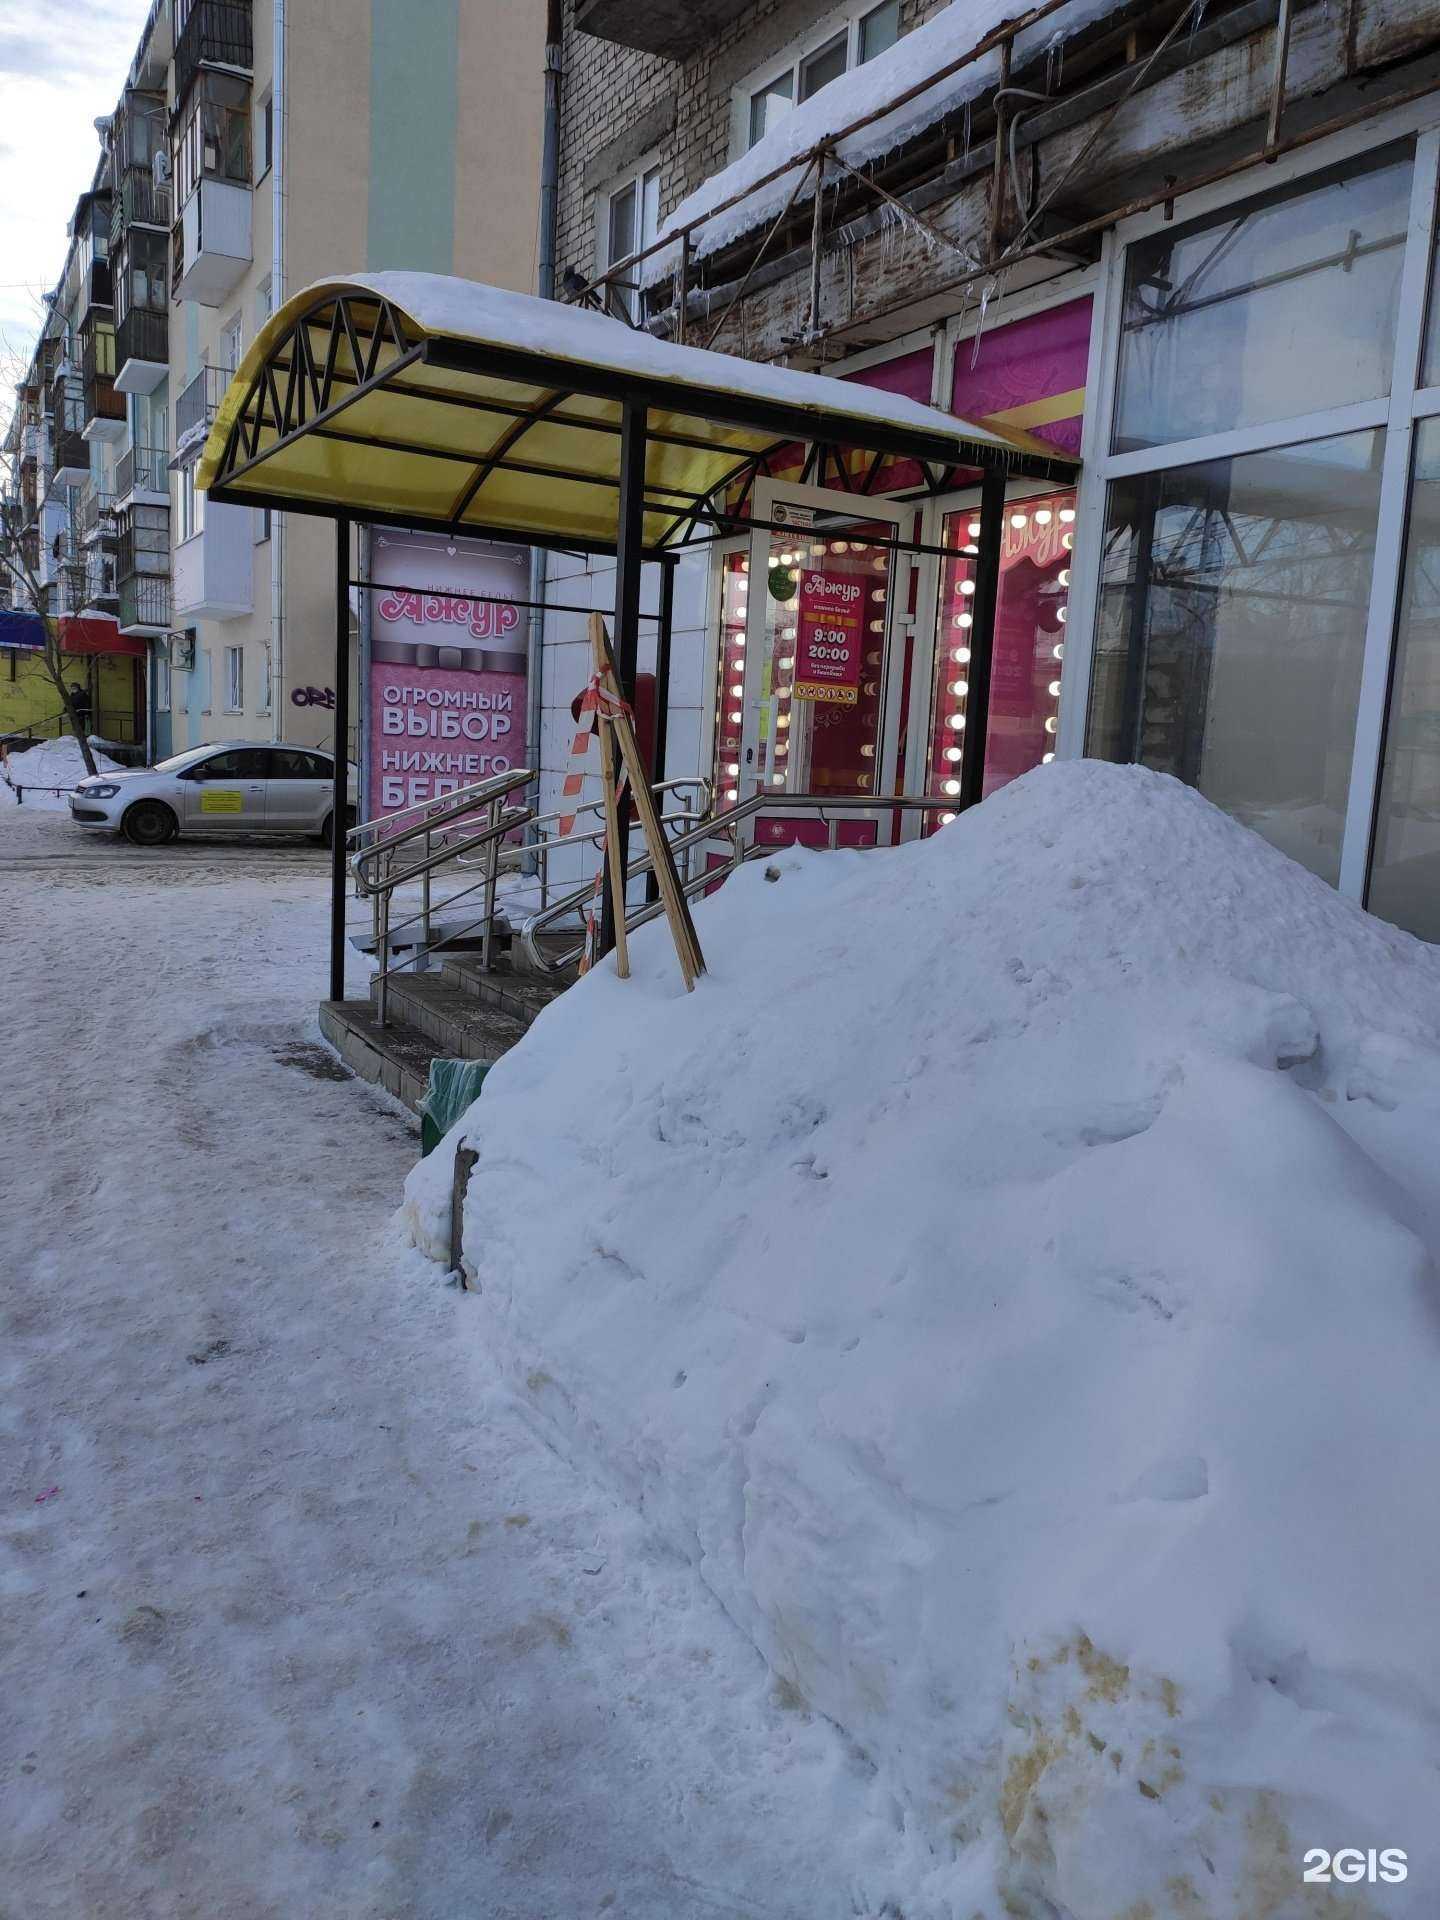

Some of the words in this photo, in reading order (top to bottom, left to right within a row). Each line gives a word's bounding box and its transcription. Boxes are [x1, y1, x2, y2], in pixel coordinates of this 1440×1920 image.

[805, 575, 860, 601] Ажур
[379, 585, 519, 637] Ажур
[814, 629, 846, 643] 9:00
[809, 645, 849, 661] 20:00
[383, 686, 512, 711] ОГРОМНЫЙ
[382, 707, 511, 740] ВЫБОР
[382, 751, 510, 774] НИЖНЕГО
